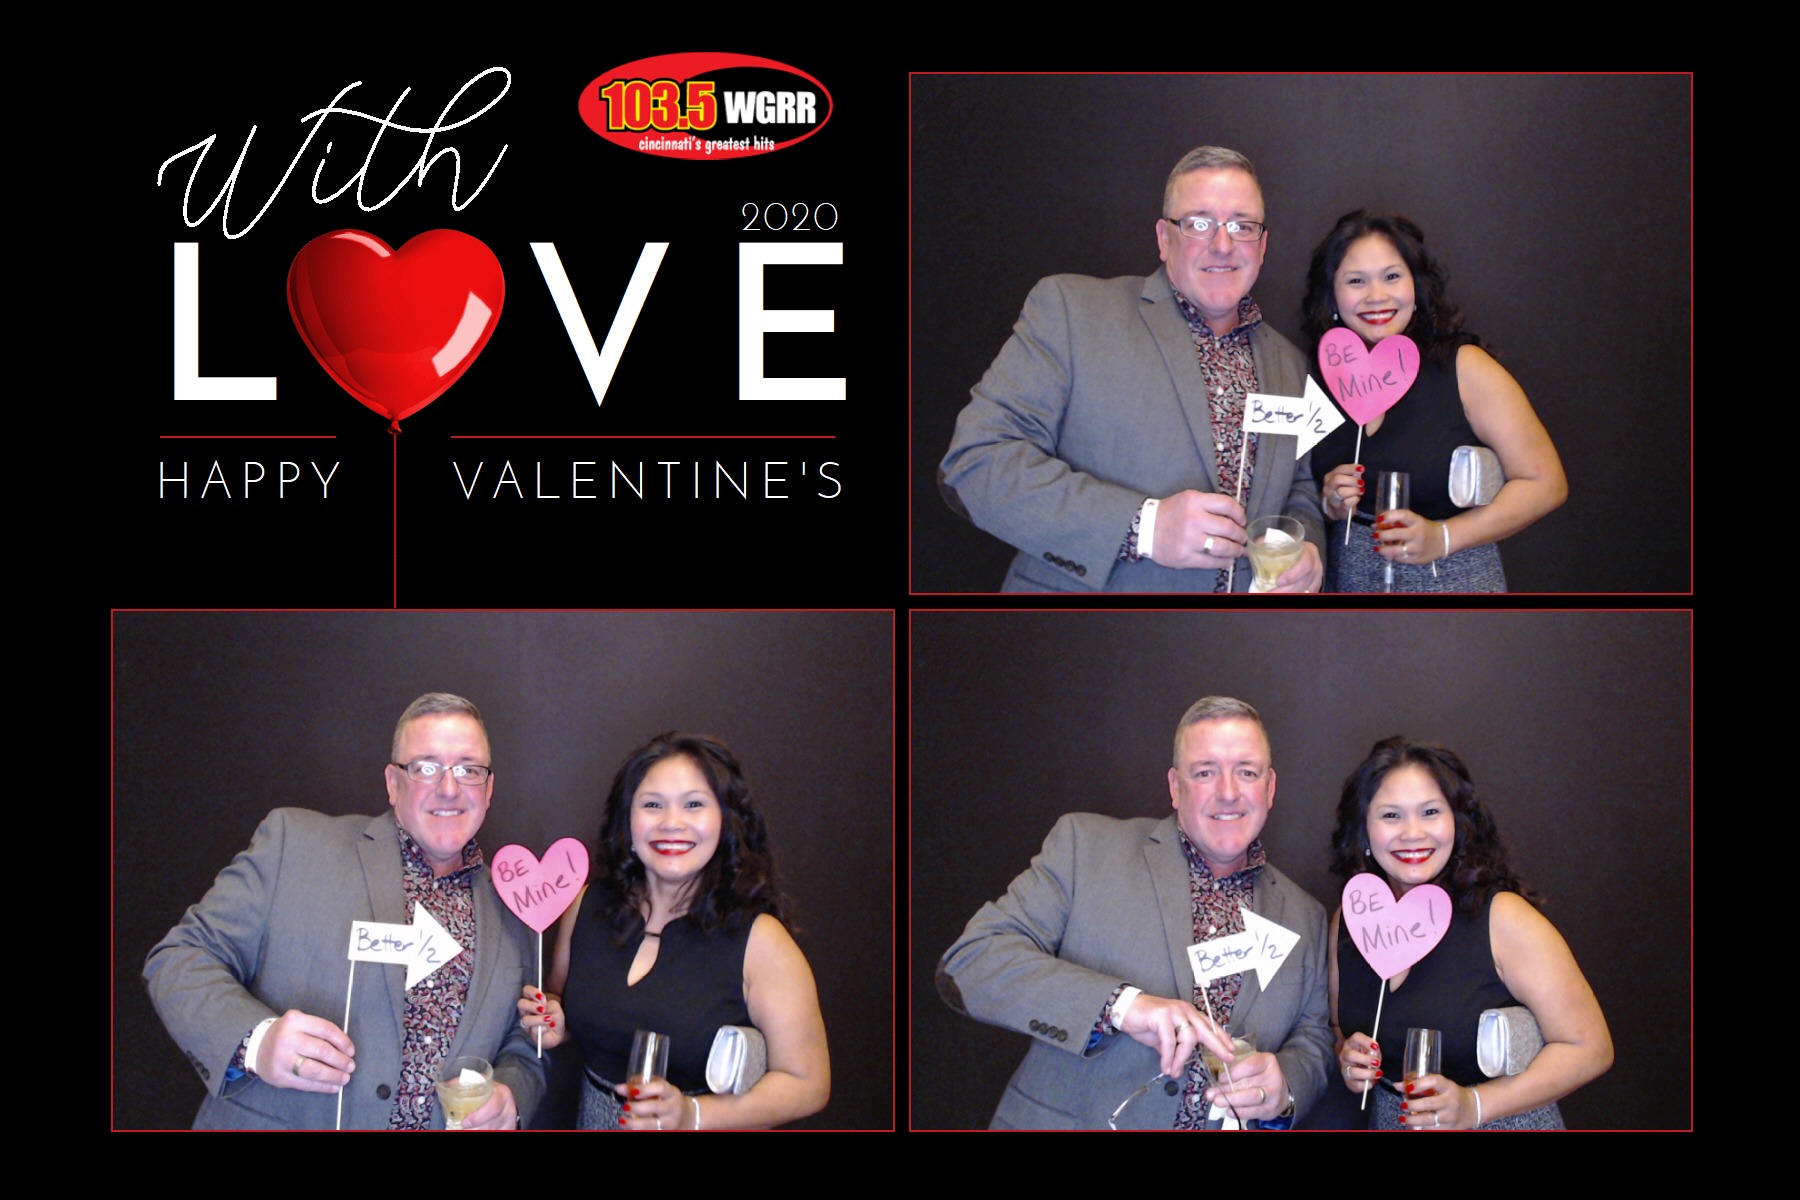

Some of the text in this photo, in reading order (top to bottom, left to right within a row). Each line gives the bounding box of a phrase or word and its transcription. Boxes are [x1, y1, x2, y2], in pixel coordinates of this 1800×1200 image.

[1325, 342, 1358, 367] BE
[1337, 347, 1409, 402] Mine!
[1251, 399, 1305, 425] Better
[496, 858, 530, 883] BE
[511, 850, 581, 914] Mine!
[1348, 889, 1384, 915] BE
[1361, 898, 1438, 953] Mine!
[356, 927, 415, 953] Better
[1194, 945, 1254, 973] Better
